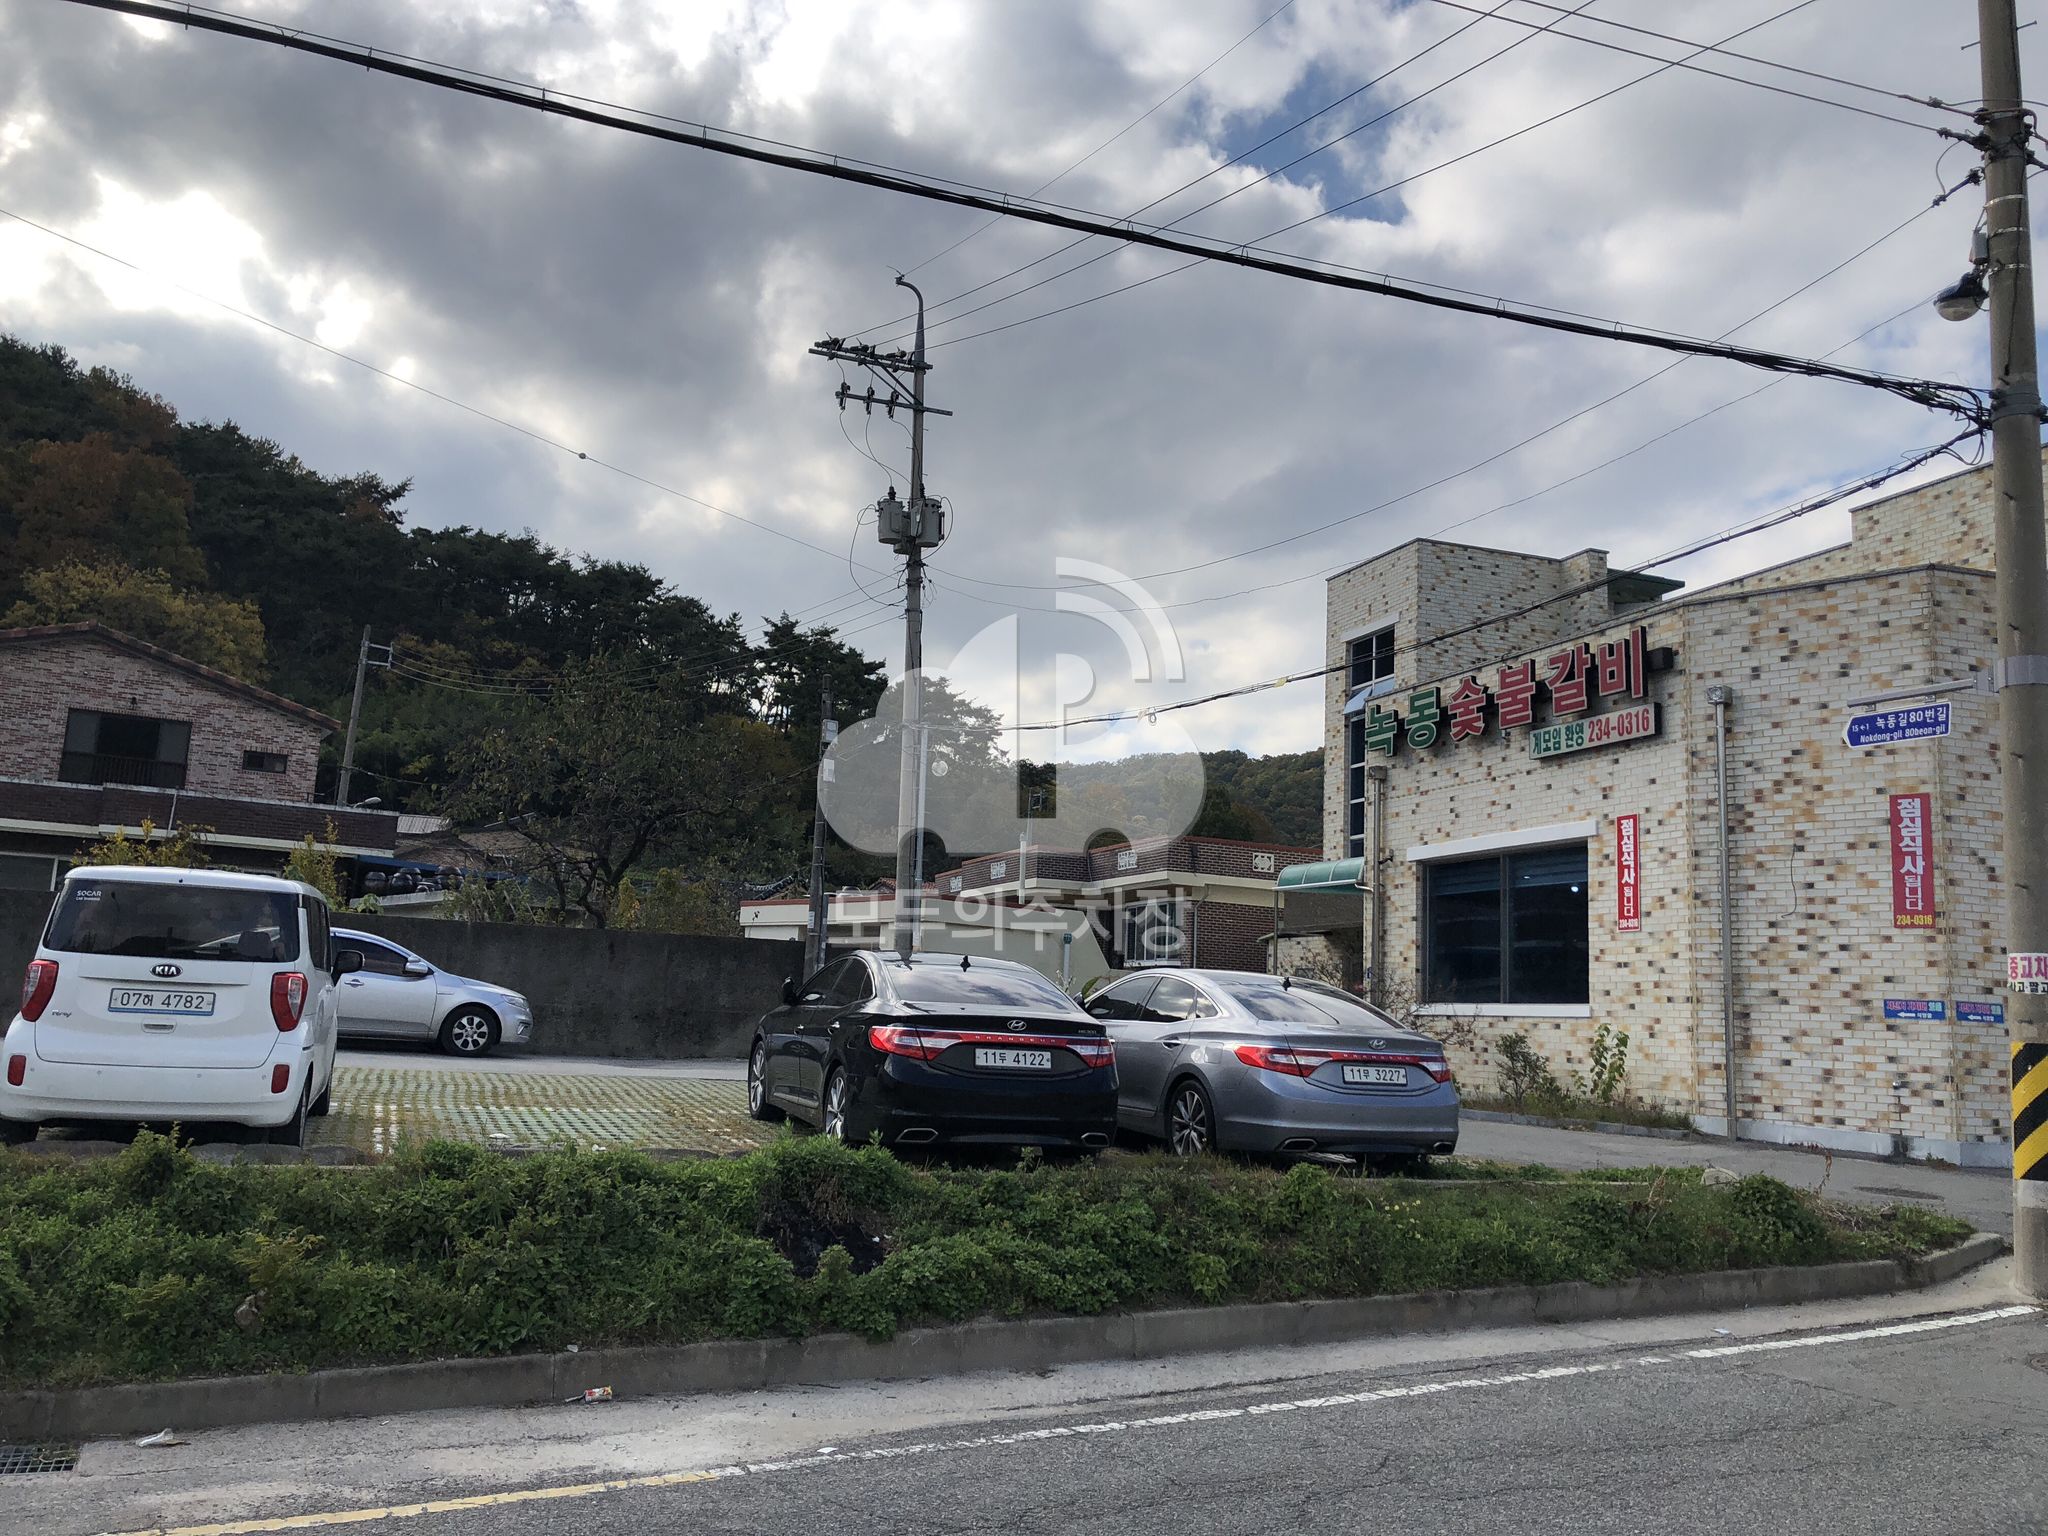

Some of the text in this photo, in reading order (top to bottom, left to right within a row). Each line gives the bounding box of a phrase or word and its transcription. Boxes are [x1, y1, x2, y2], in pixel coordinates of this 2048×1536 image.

[1365, 686, 1441, 757] 녹동
[1565, 722, 1584, 748] 환영
[1588, 708, 1650, 743] 234-0316
[1876, 707, 1946, 729] 녹동길80번길
[1860, 723, 1946, 743] Nokdong-gil 80beon-gil
[1897, 798, 1926, 875] 점심식사
[1620, 818, 1635, 885] 점심식사
[1896, 914, 1933, 926] 234-0316
[154, 966, 178, 976] KIA
[120, 992, 205, 1009] 07허 4782
[983, 1051, 1045, 1066] 11두 4122
[1375, 1069, 1400, 1082] 3227
